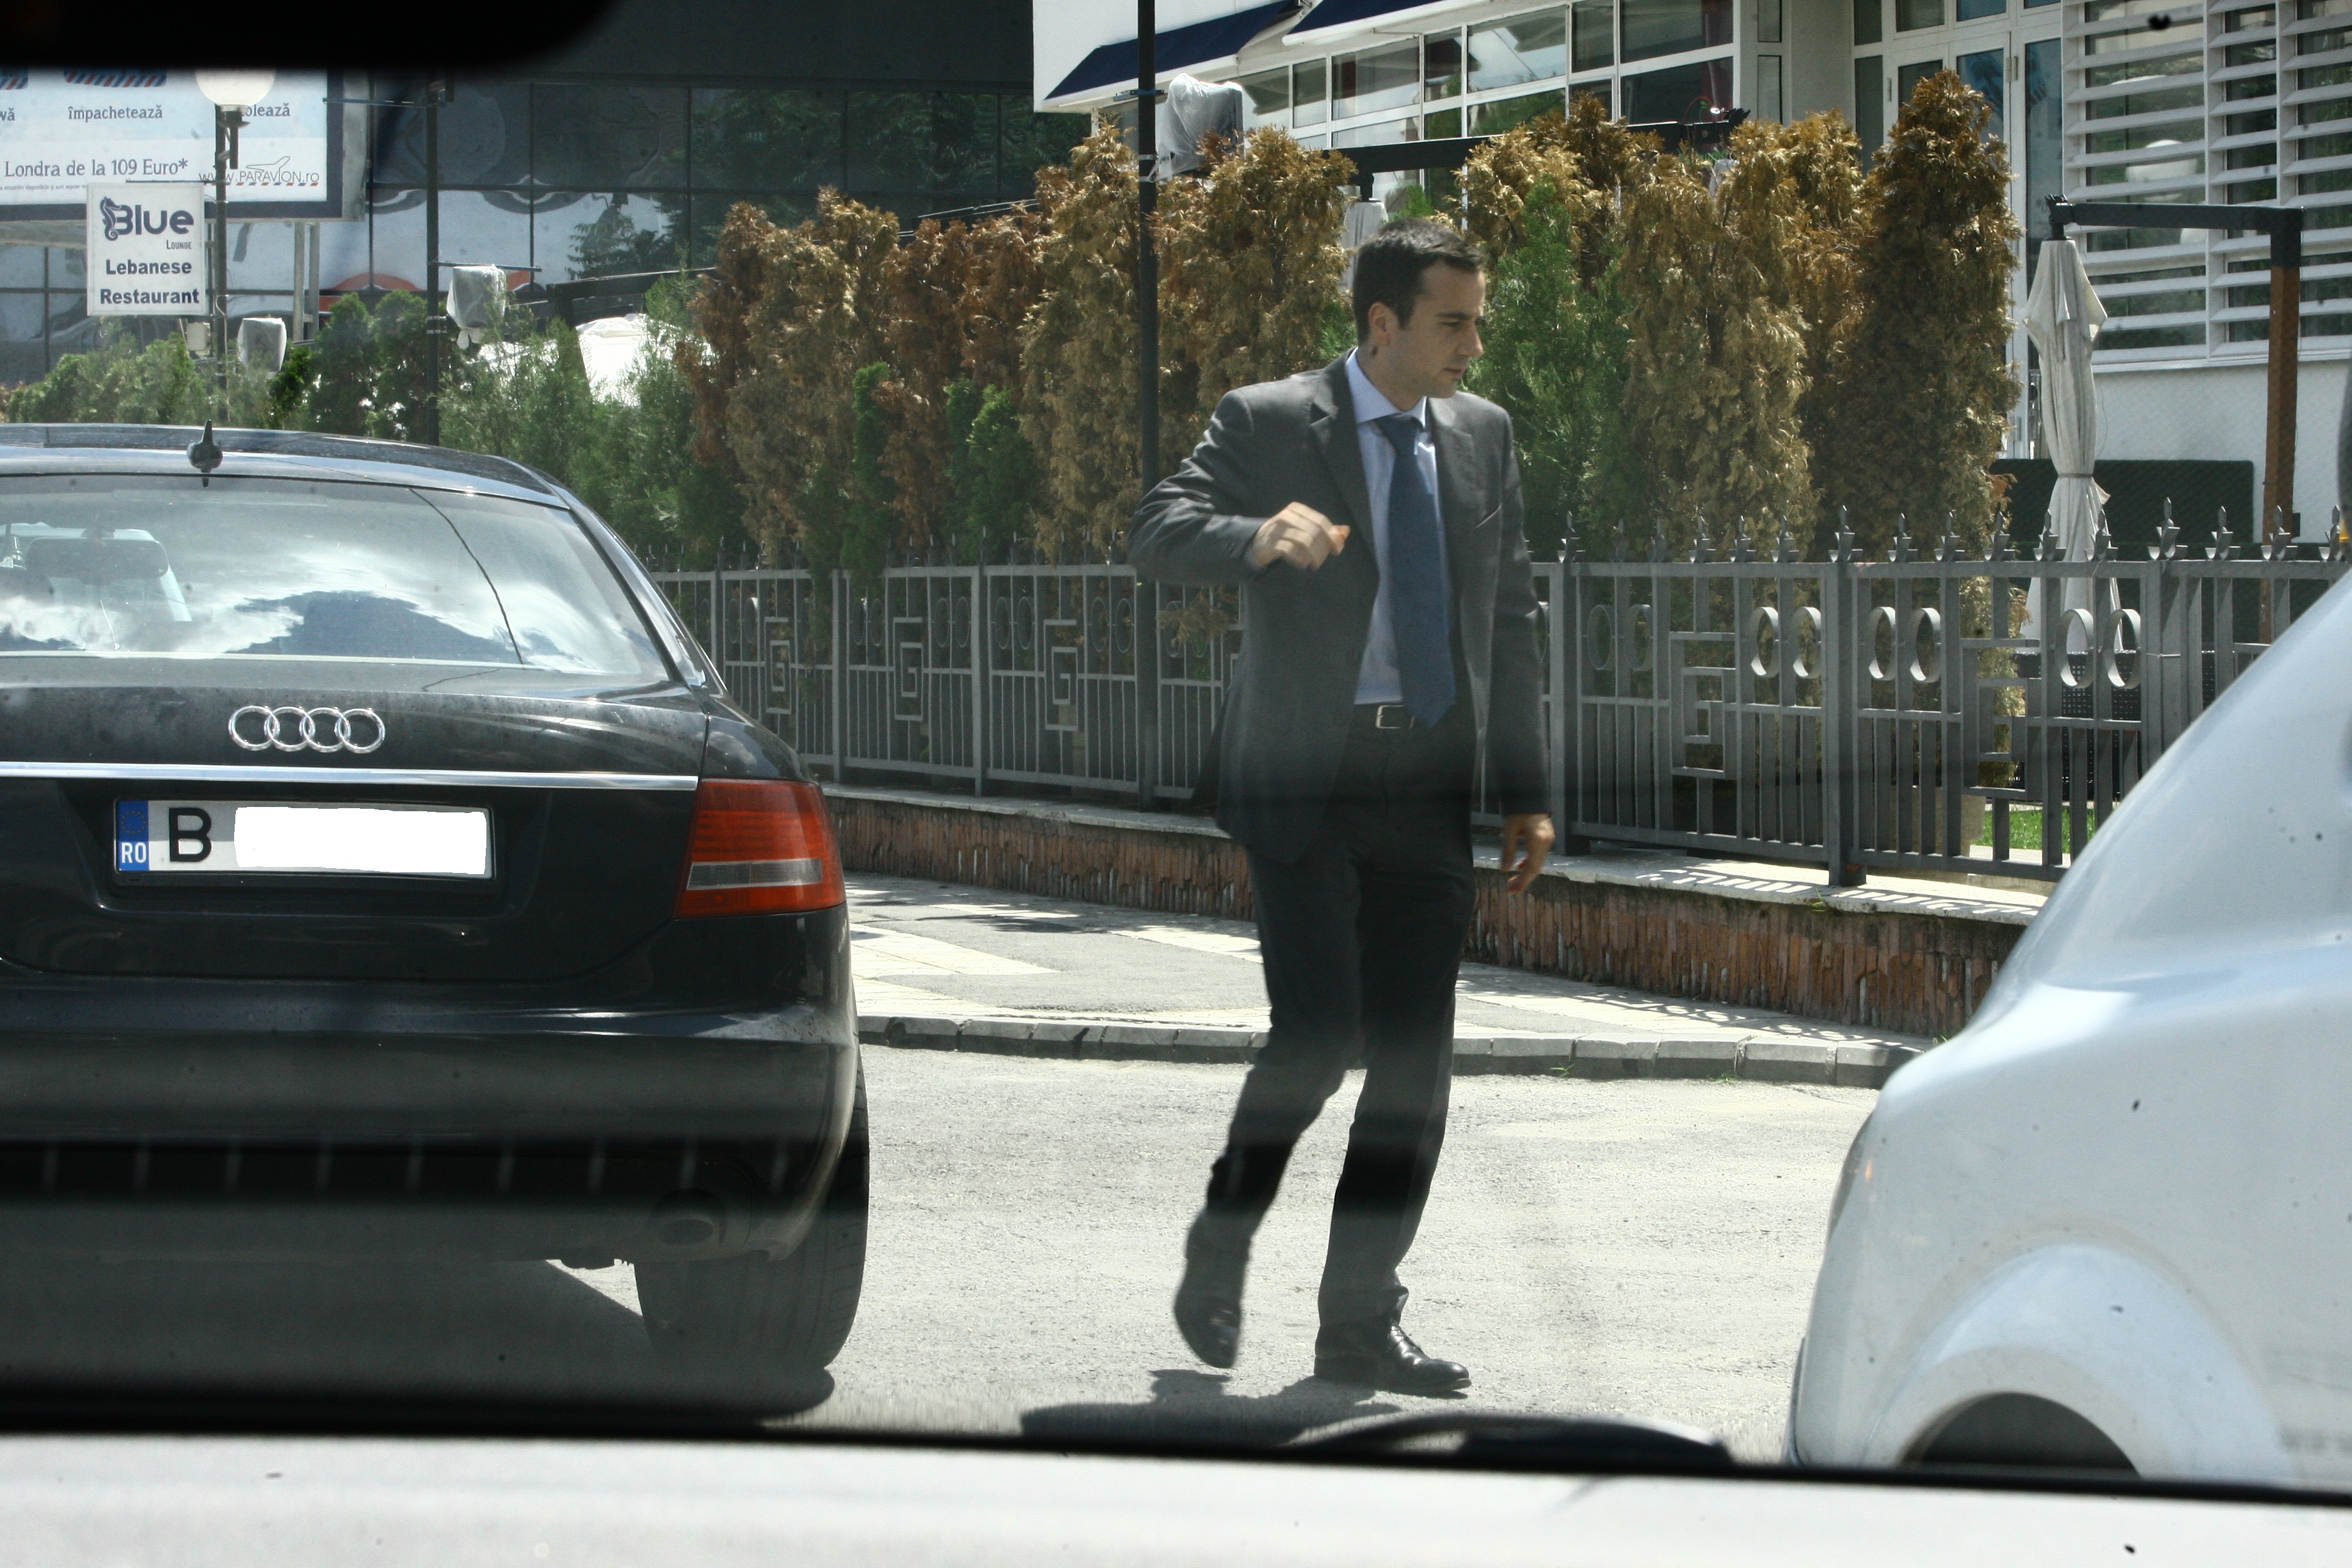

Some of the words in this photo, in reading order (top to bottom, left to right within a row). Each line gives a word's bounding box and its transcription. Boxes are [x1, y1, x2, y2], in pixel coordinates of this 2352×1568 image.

[68, 105, 163, 122] împachetează
[242, 102, 290, 117] olează
[5, 160, 60, 177] Londra
[66, 160, 85, 175] de
[91, 159, 106, 175] la
[111, 159, 137, 175] 109
[100, 197, 194, 241] Blue
[106, 260, 192, 275] Lebanese
[100, 289, 200, 304] Restaurant
[169, 807, 212, 862] B
[121, 841, 147, 863] RO
